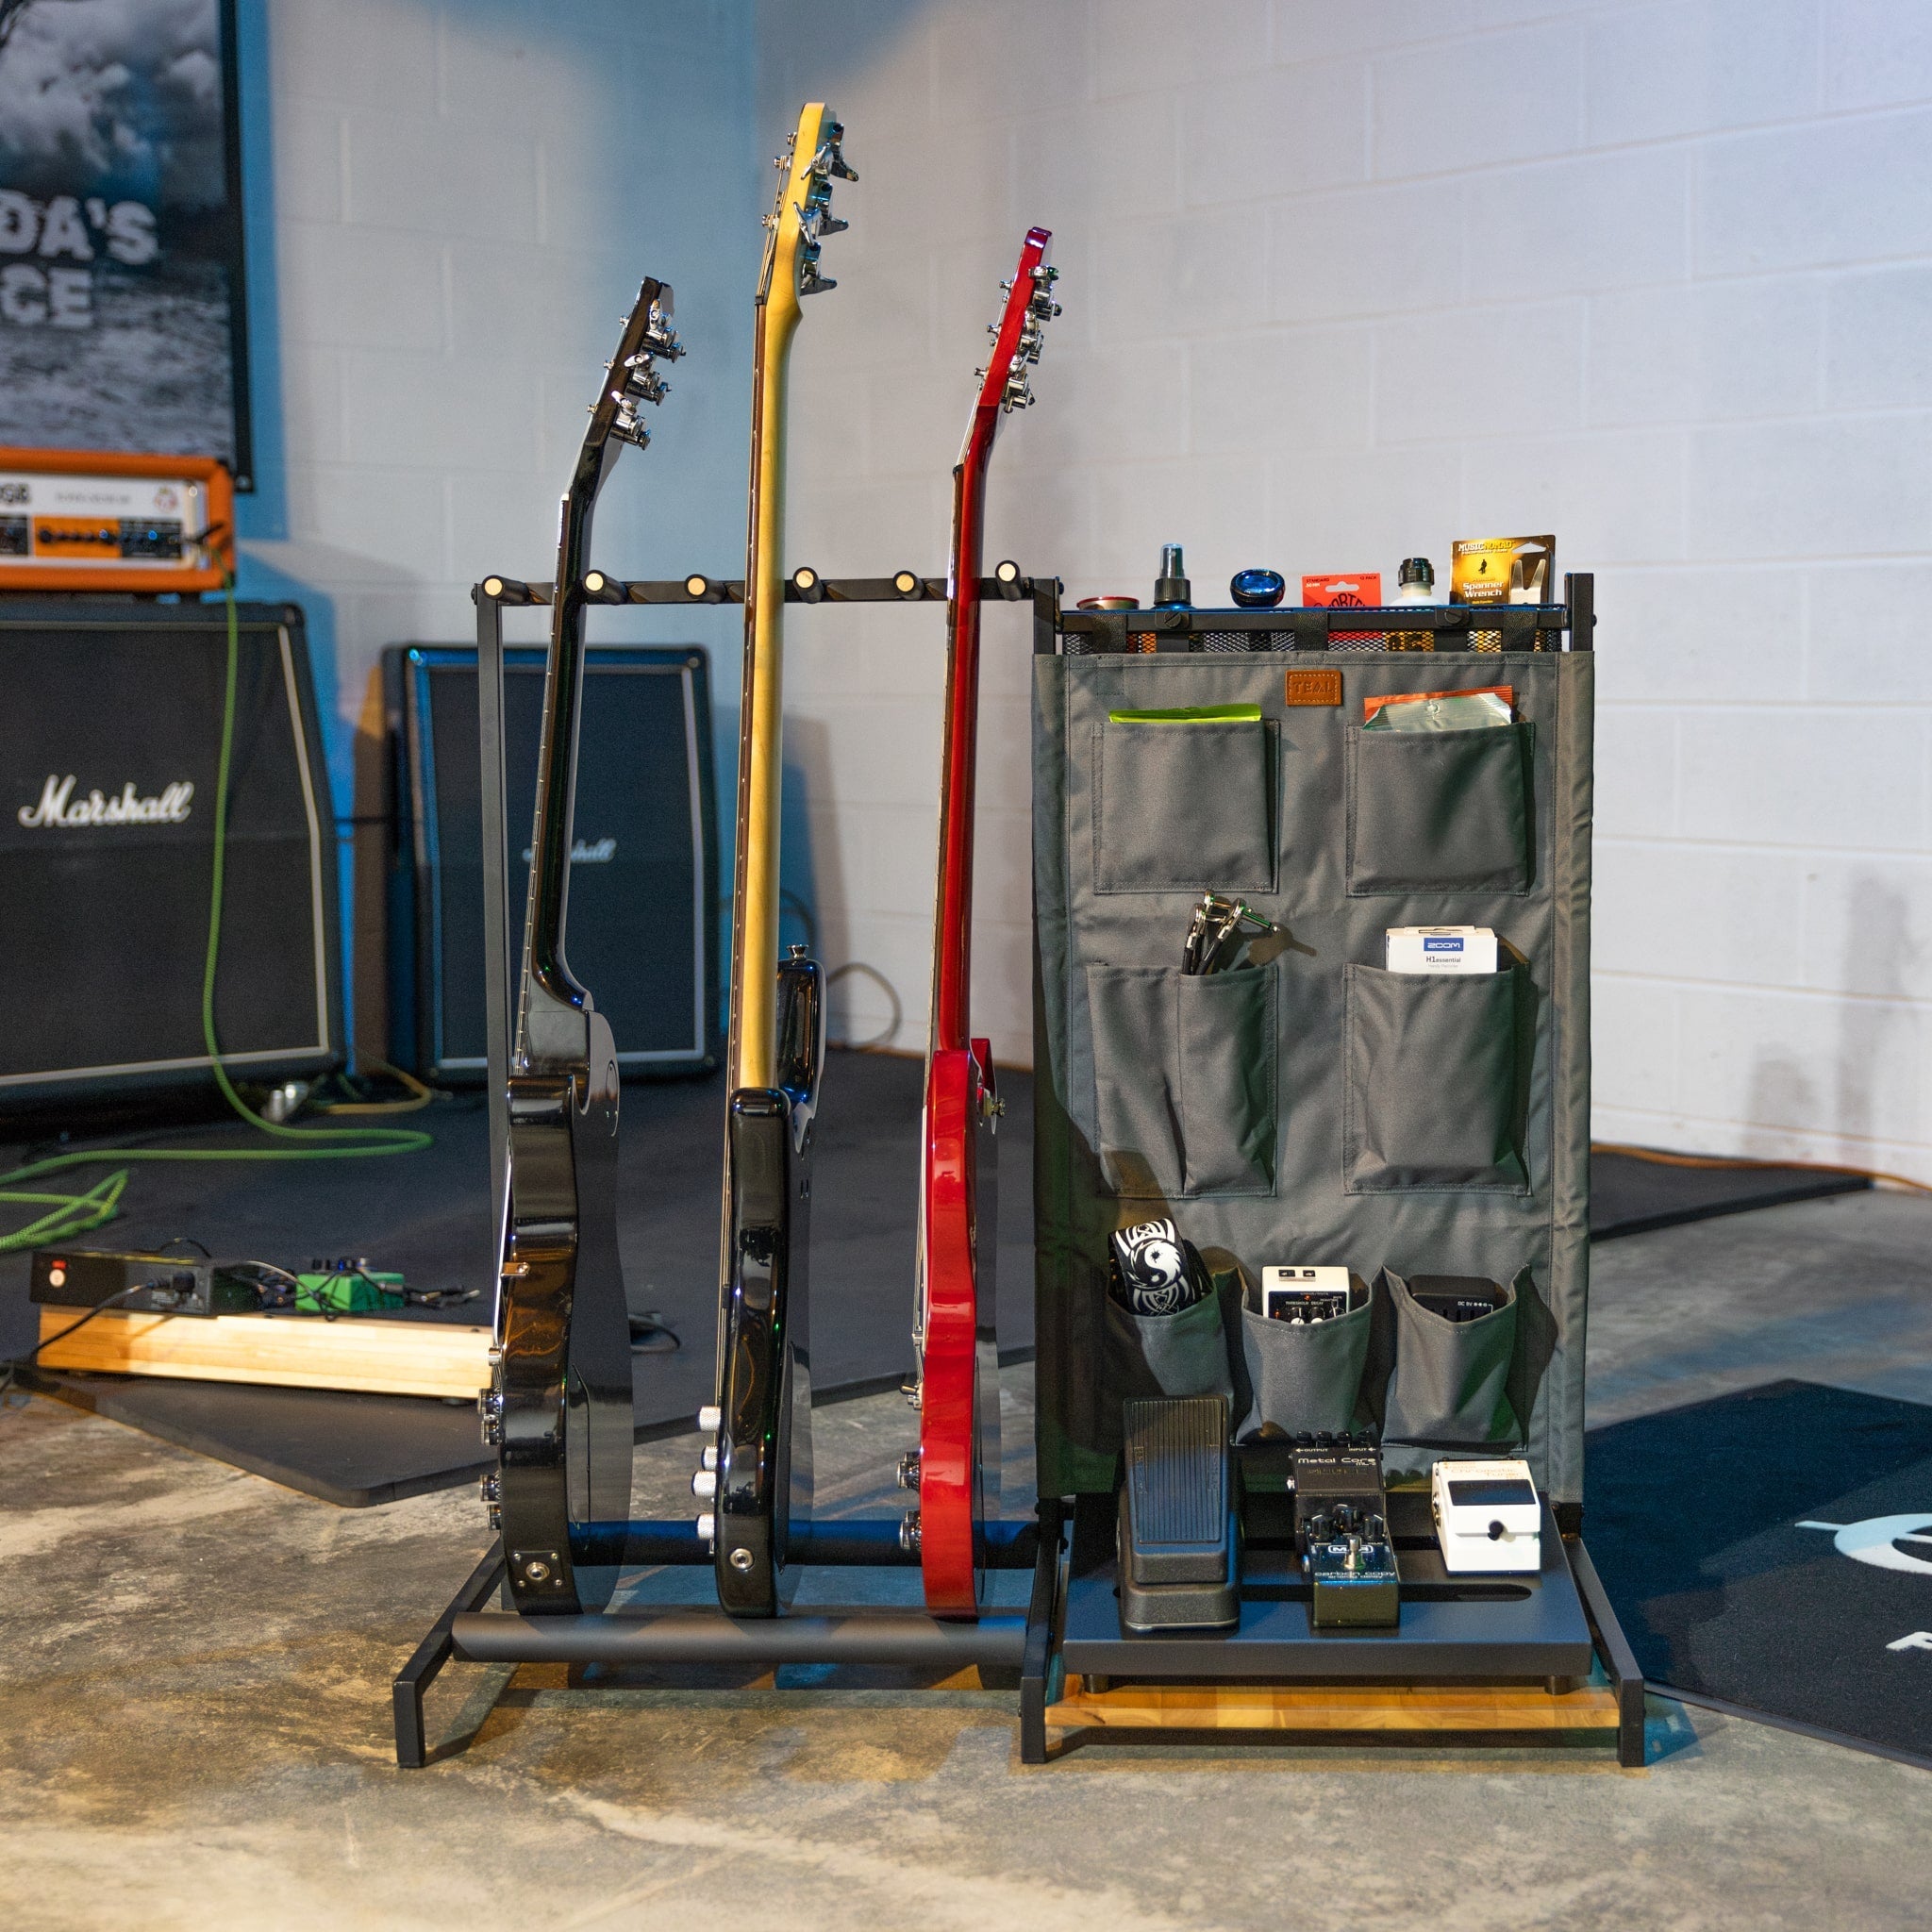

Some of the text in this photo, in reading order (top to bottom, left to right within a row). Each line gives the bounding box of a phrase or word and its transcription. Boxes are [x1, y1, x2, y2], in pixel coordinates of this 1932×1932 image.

[0, 189, 158, 265] DA'S
[0, 263, 92, 327] CE
[1463, 581, 1504, 591] Spanner
[1464, 589, 1502, 598] Wrench
[18, 774, 194, 827] Marshall
